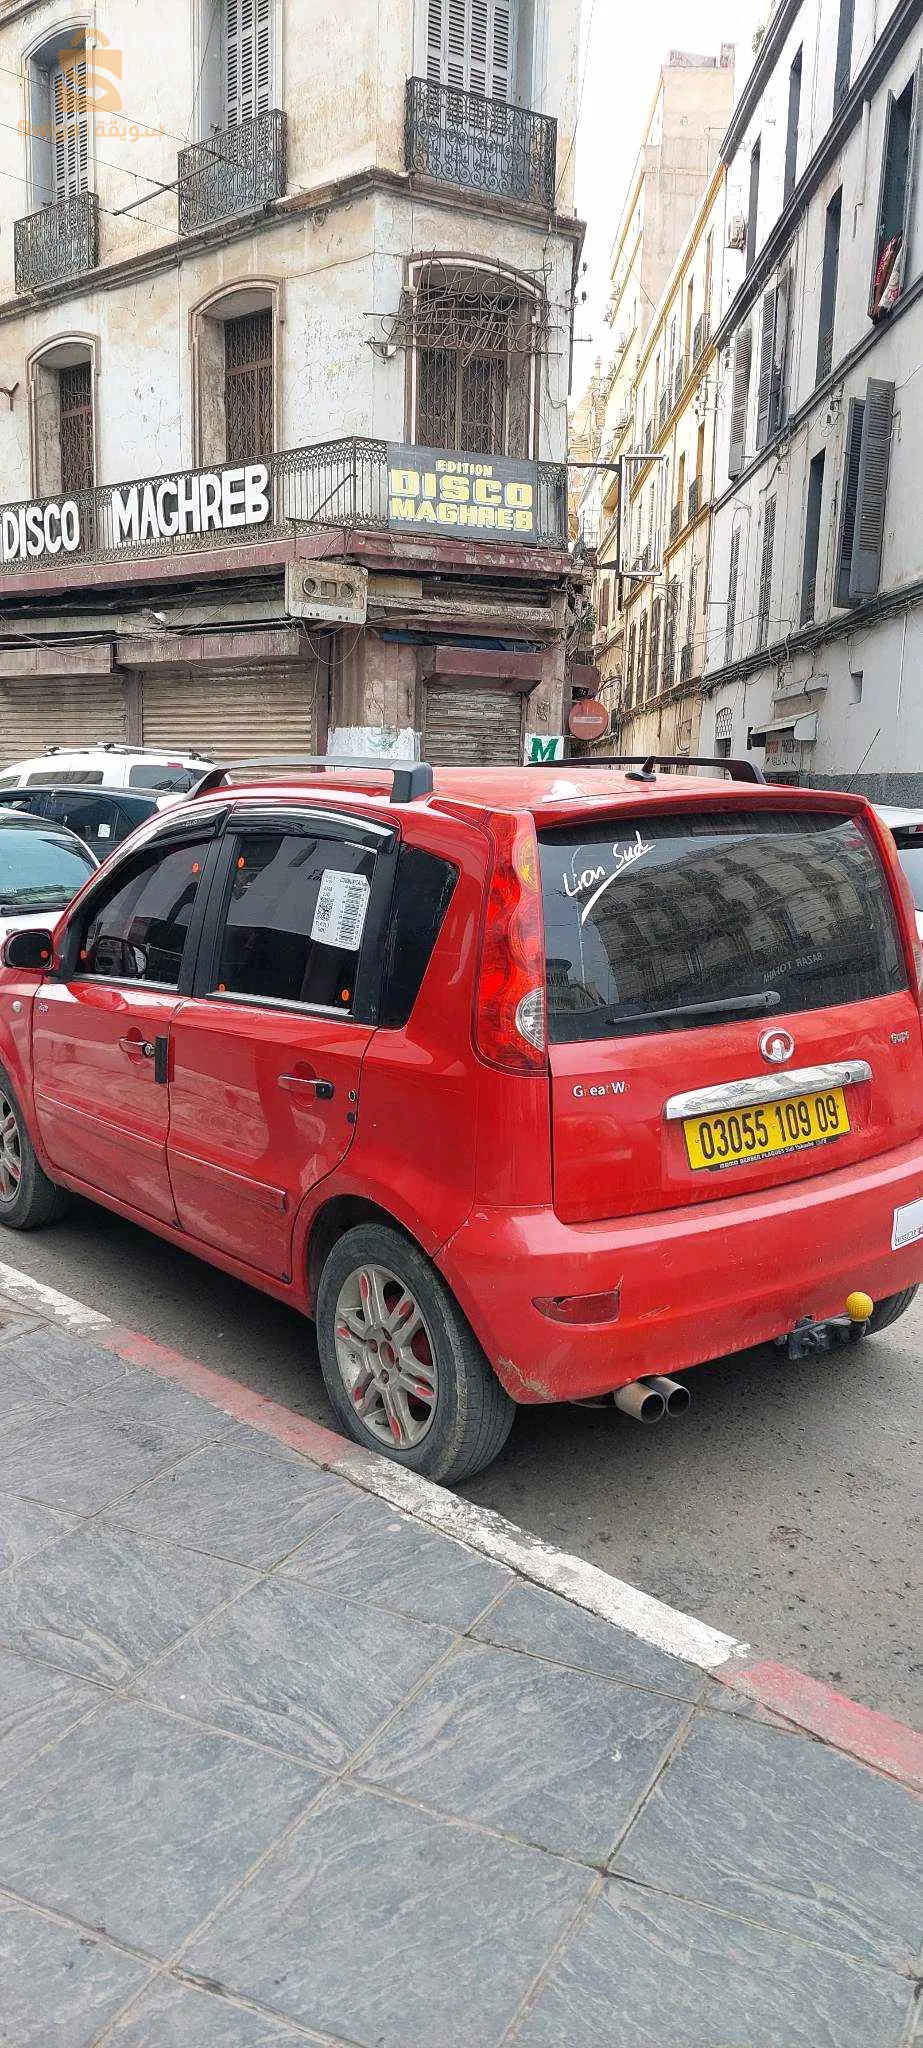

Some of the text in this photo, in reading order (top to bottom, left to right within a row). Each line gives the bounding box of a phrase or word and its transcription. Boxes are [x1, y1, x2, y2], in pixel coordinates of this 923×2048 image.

[435, 459, 493, 477] EDITION
[388, 468, 533, 510] DISCO
[0, 463, 270, 560] DISCO MAGHREB
[390, 498, 533, 532] MAGHREB
[612, 830, 650, 870] Sud
[699, 1095, 839, 1159] 03055 109 09
